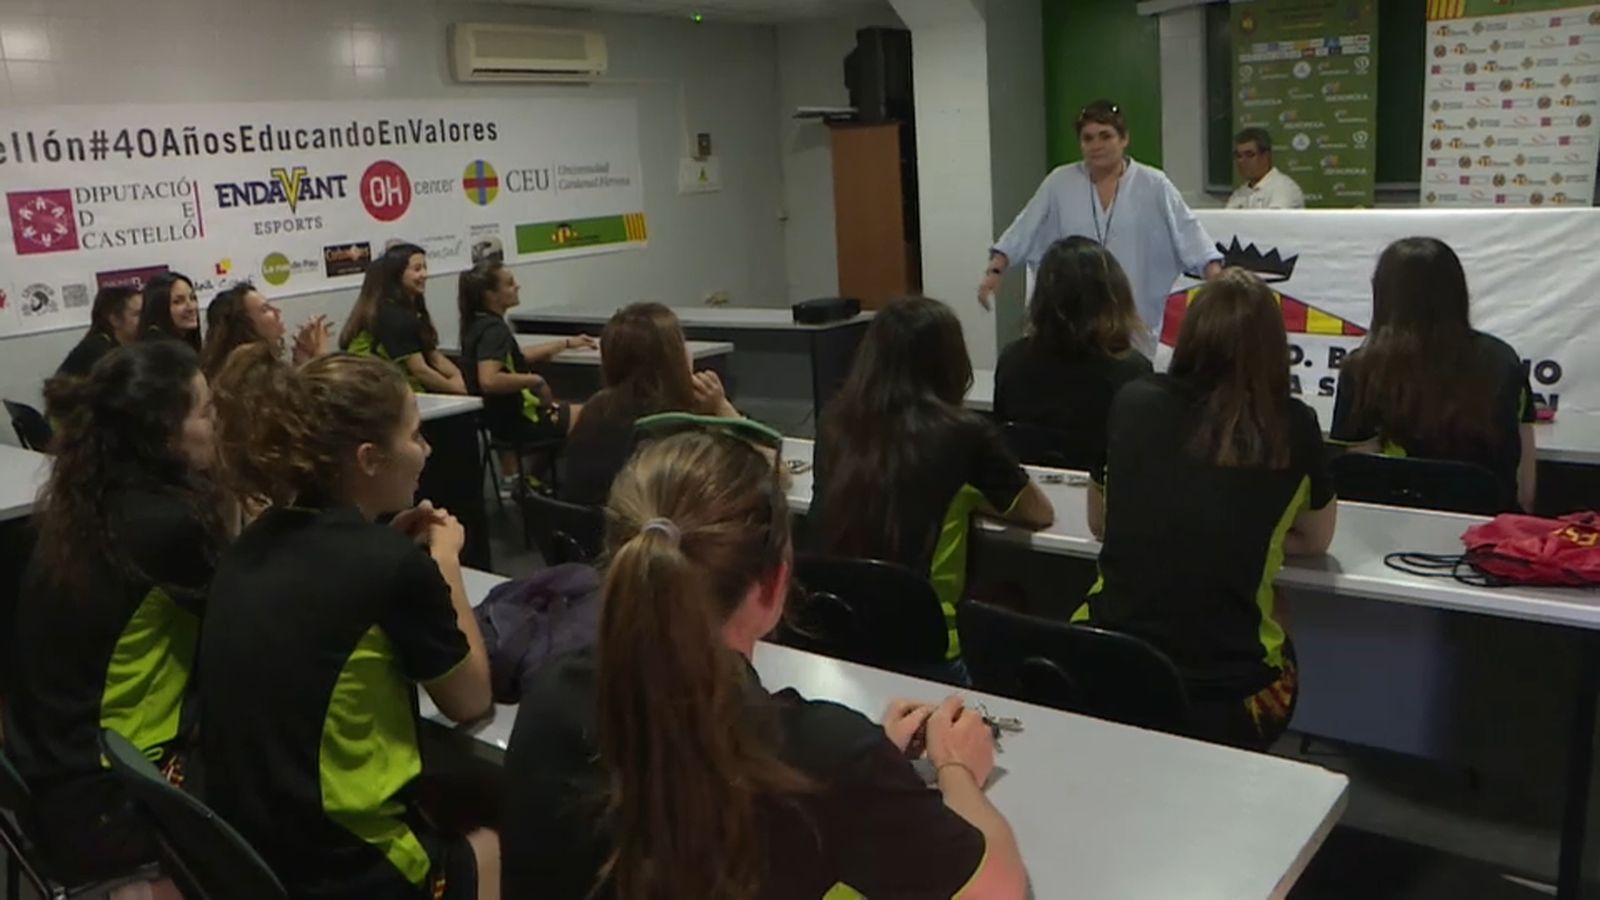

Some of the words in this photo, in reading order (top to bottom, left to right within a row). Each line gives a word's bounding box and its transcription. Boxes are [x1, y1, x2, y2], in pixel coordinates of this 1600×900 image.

[75, 175, 192, 205] DIPUTACIÓ
[214, 166, 348, 214] ENDAVANT
[369, 175, 404, 208] OH
[414, 178, 455, 195] center
[506, 168, 550, 193] CEU
[81, 219, 198, 250] CASTELLÓ
[254, 215, 323, 236] ESPORTS
